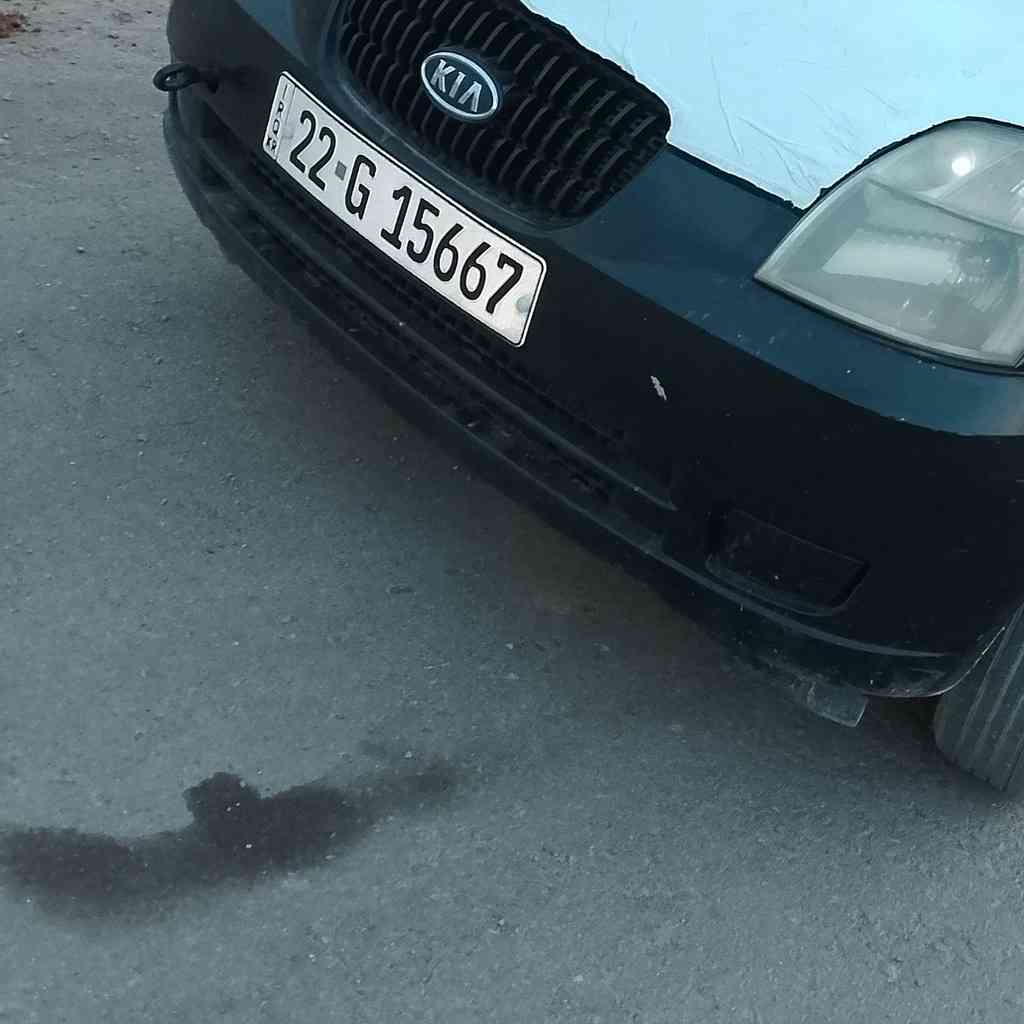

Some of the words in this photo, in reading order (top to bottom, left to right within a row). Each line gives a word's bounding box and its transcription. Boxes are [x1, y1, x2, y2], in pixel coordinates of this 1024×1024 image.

[430, 59, 482, 113] KIA
[289, 109, 337, 193] 22
[344, 154, 377, 221] G
[380, 184, 525, 316] 15667
